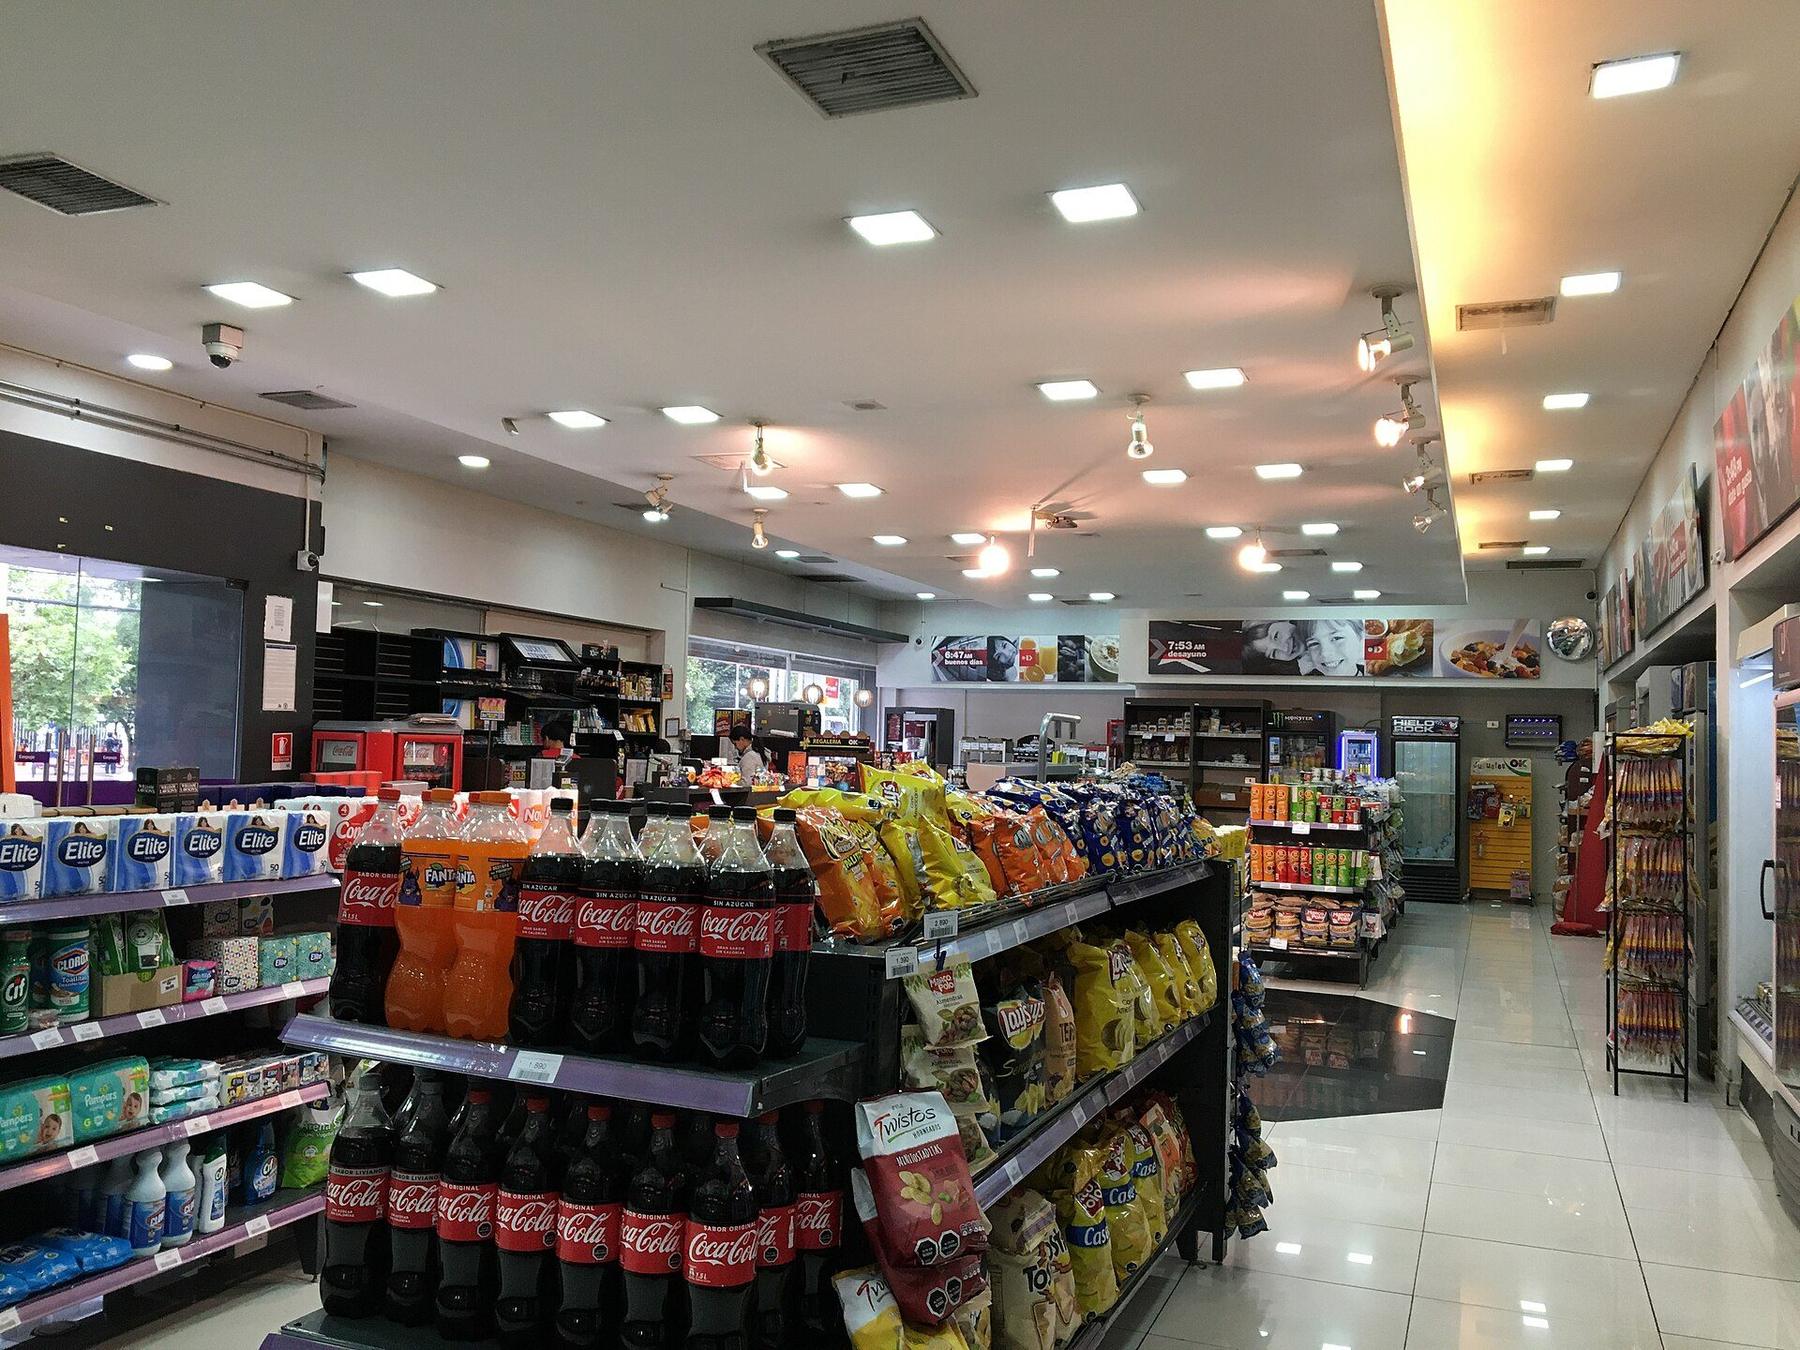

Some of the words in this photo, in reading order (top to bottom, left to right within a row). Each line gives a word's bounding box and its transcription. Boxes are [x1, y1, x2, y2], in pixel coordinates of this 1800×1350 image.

[1168, 641, 1193, 650] 7:53
[945, 651, 964, 660] 6:47
[1168, 650, 1207, 659] desayuno
[969, 658, 984, 666] días
[1394, 719, 1435, 727] HIELO
[1510, 759, 1527, 768] OK
[188, 835, 220, 854] Elite
[241, 831, 275, 850] Elite
[298, 830, 325, 847] Elite
[65, 843, 103, 862] Elite
[133, 838, 169, 857] Elite
[0, 848, 37, 865] Elite
[270, 863, 279, 872] 50
[701, 909, 772, 942] Coca-Cola
[5, 976, 26, 1001] Cif
[938, 981, 955, 993] Polo
[999, 1004, 1034, 1034] Lay's
[84, 1091, 117, 1107] Pampers
[874, 1106, 937, 1149] Twistos
[912, 1123, 942, 1139] HORNEADOS
[263, 1159, 274, 1175] Cif
[334, 1167, 354, 1175] SABOR
[449, 1184, 479, 1192] ORIGINAL
[513, 1193, 545, 1201] ORIGINAL
[565, 1202, 594, 1211] ORIGINAL
[638, 1212, 670, 1221] ORIGINAL
[703, 1225, 727, 1233] SABOR
[728, 1222, 756, 1233] ORIGINAL
